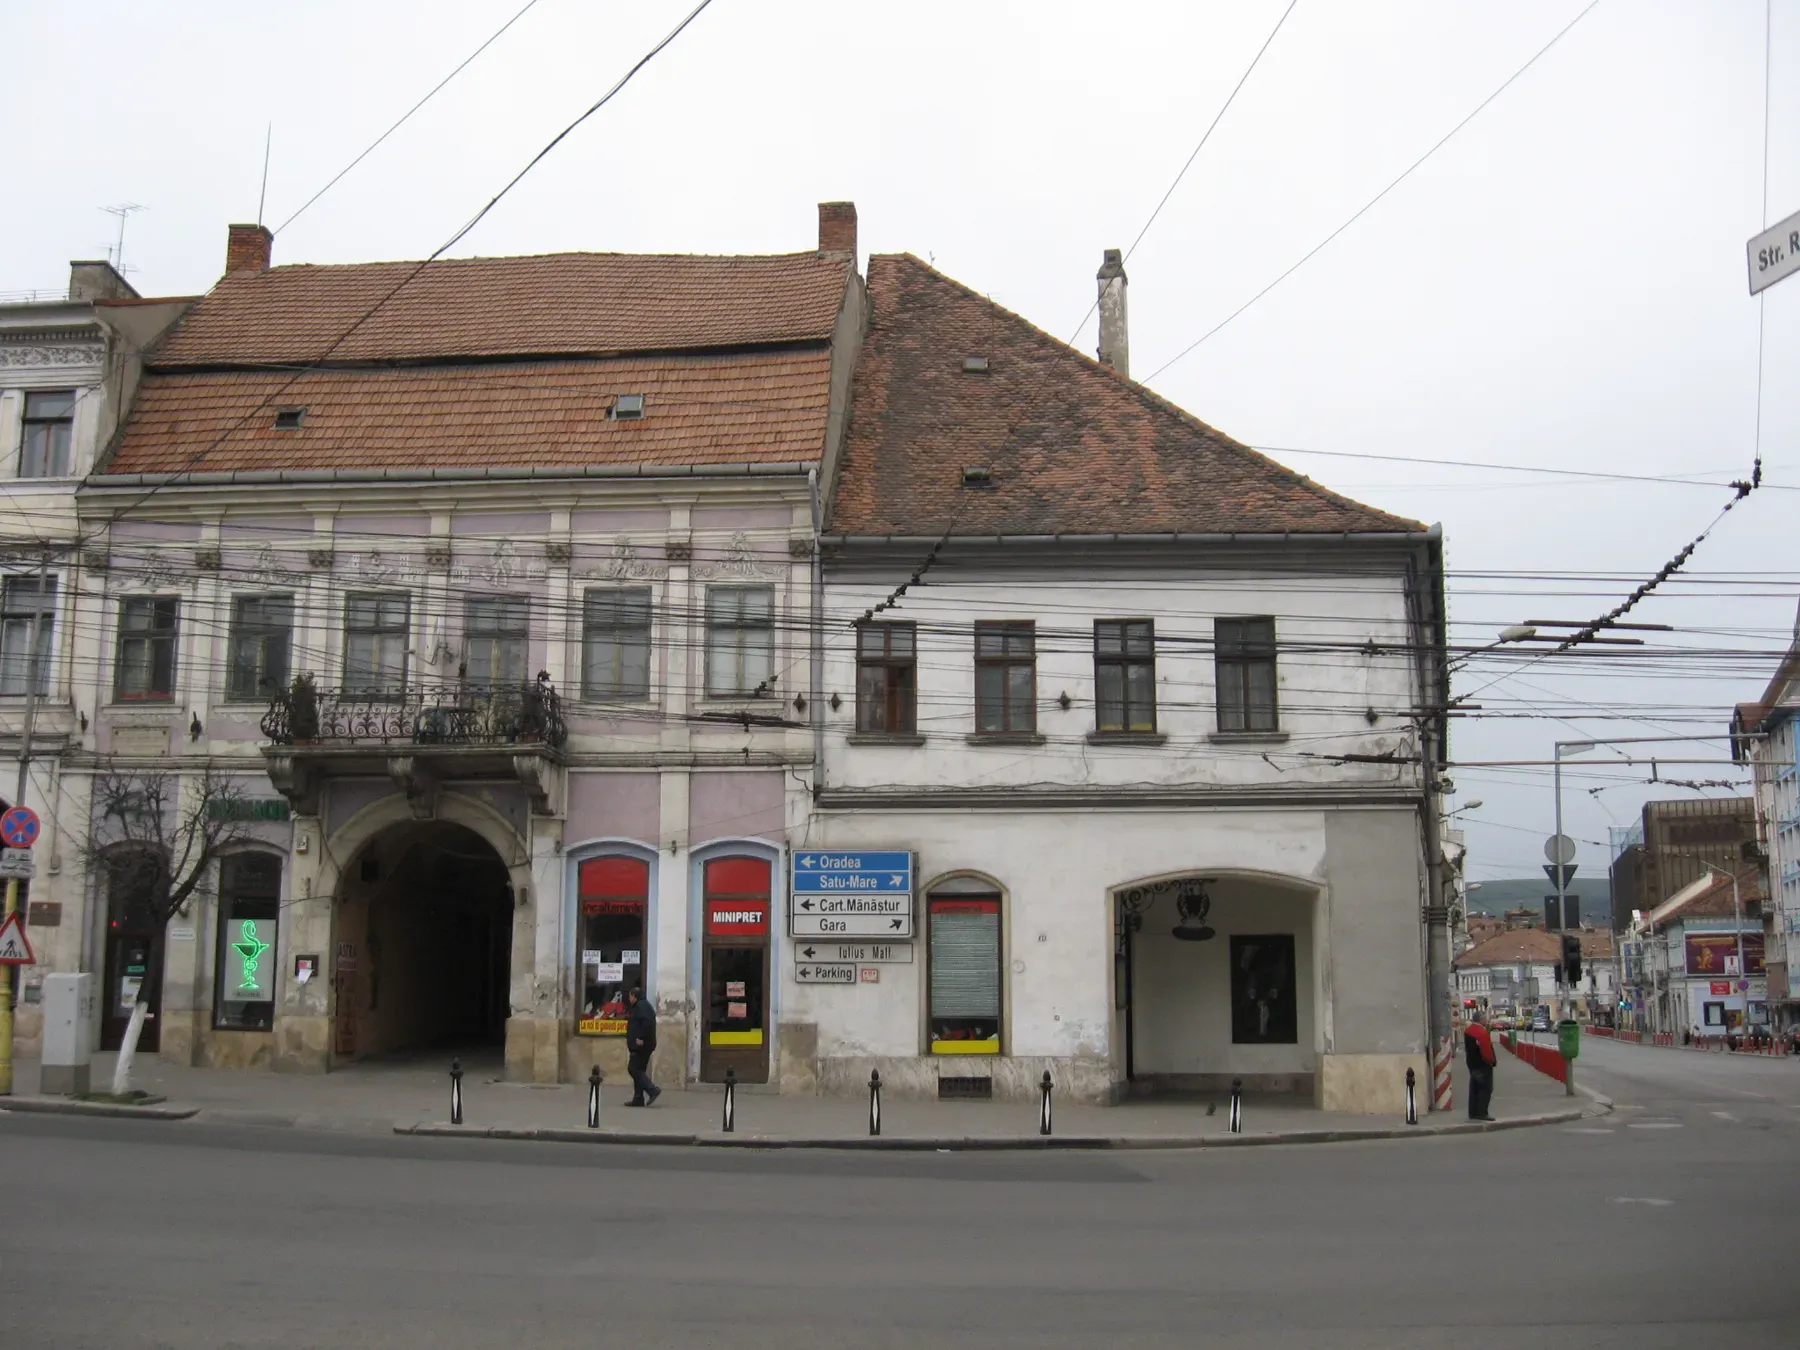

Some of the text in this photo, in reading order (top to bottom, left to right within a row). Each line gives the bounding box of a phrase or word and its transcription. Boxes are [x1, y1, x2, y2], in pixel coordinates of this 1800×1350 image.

[1758, 245, 1784, 272] Str.
[820, 855, 861, 868] Oradea
[820, 875, 878, 888] Satu-Mare
[713, 911, 762, 923] MINIPRET
[820, 918, 846, 931] Gara
[839, 945, 891, 959] Iulius Mall
[815, 966, 852, 981] Parking
